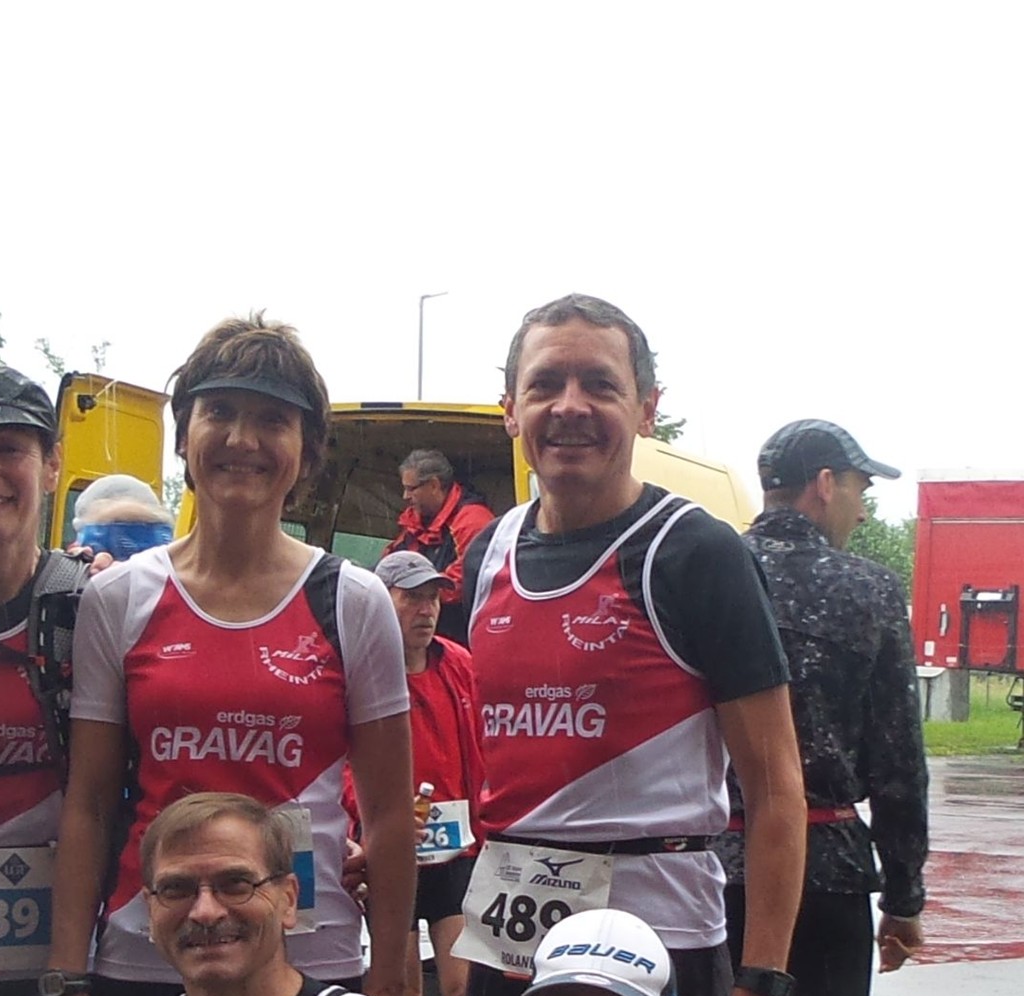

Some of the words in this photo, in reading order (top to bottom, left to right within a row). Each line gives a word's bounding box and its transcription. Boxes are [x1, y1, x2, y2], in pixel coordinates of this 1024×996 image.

[525, 684, 573, 700] erdgas
[216, 709, 276, 727] erdgas
[481, 702, 607, 738] GRAVAG
[150, 726, 304, 768] GRAVAG
[546, 943, 657, 974] BAUER
